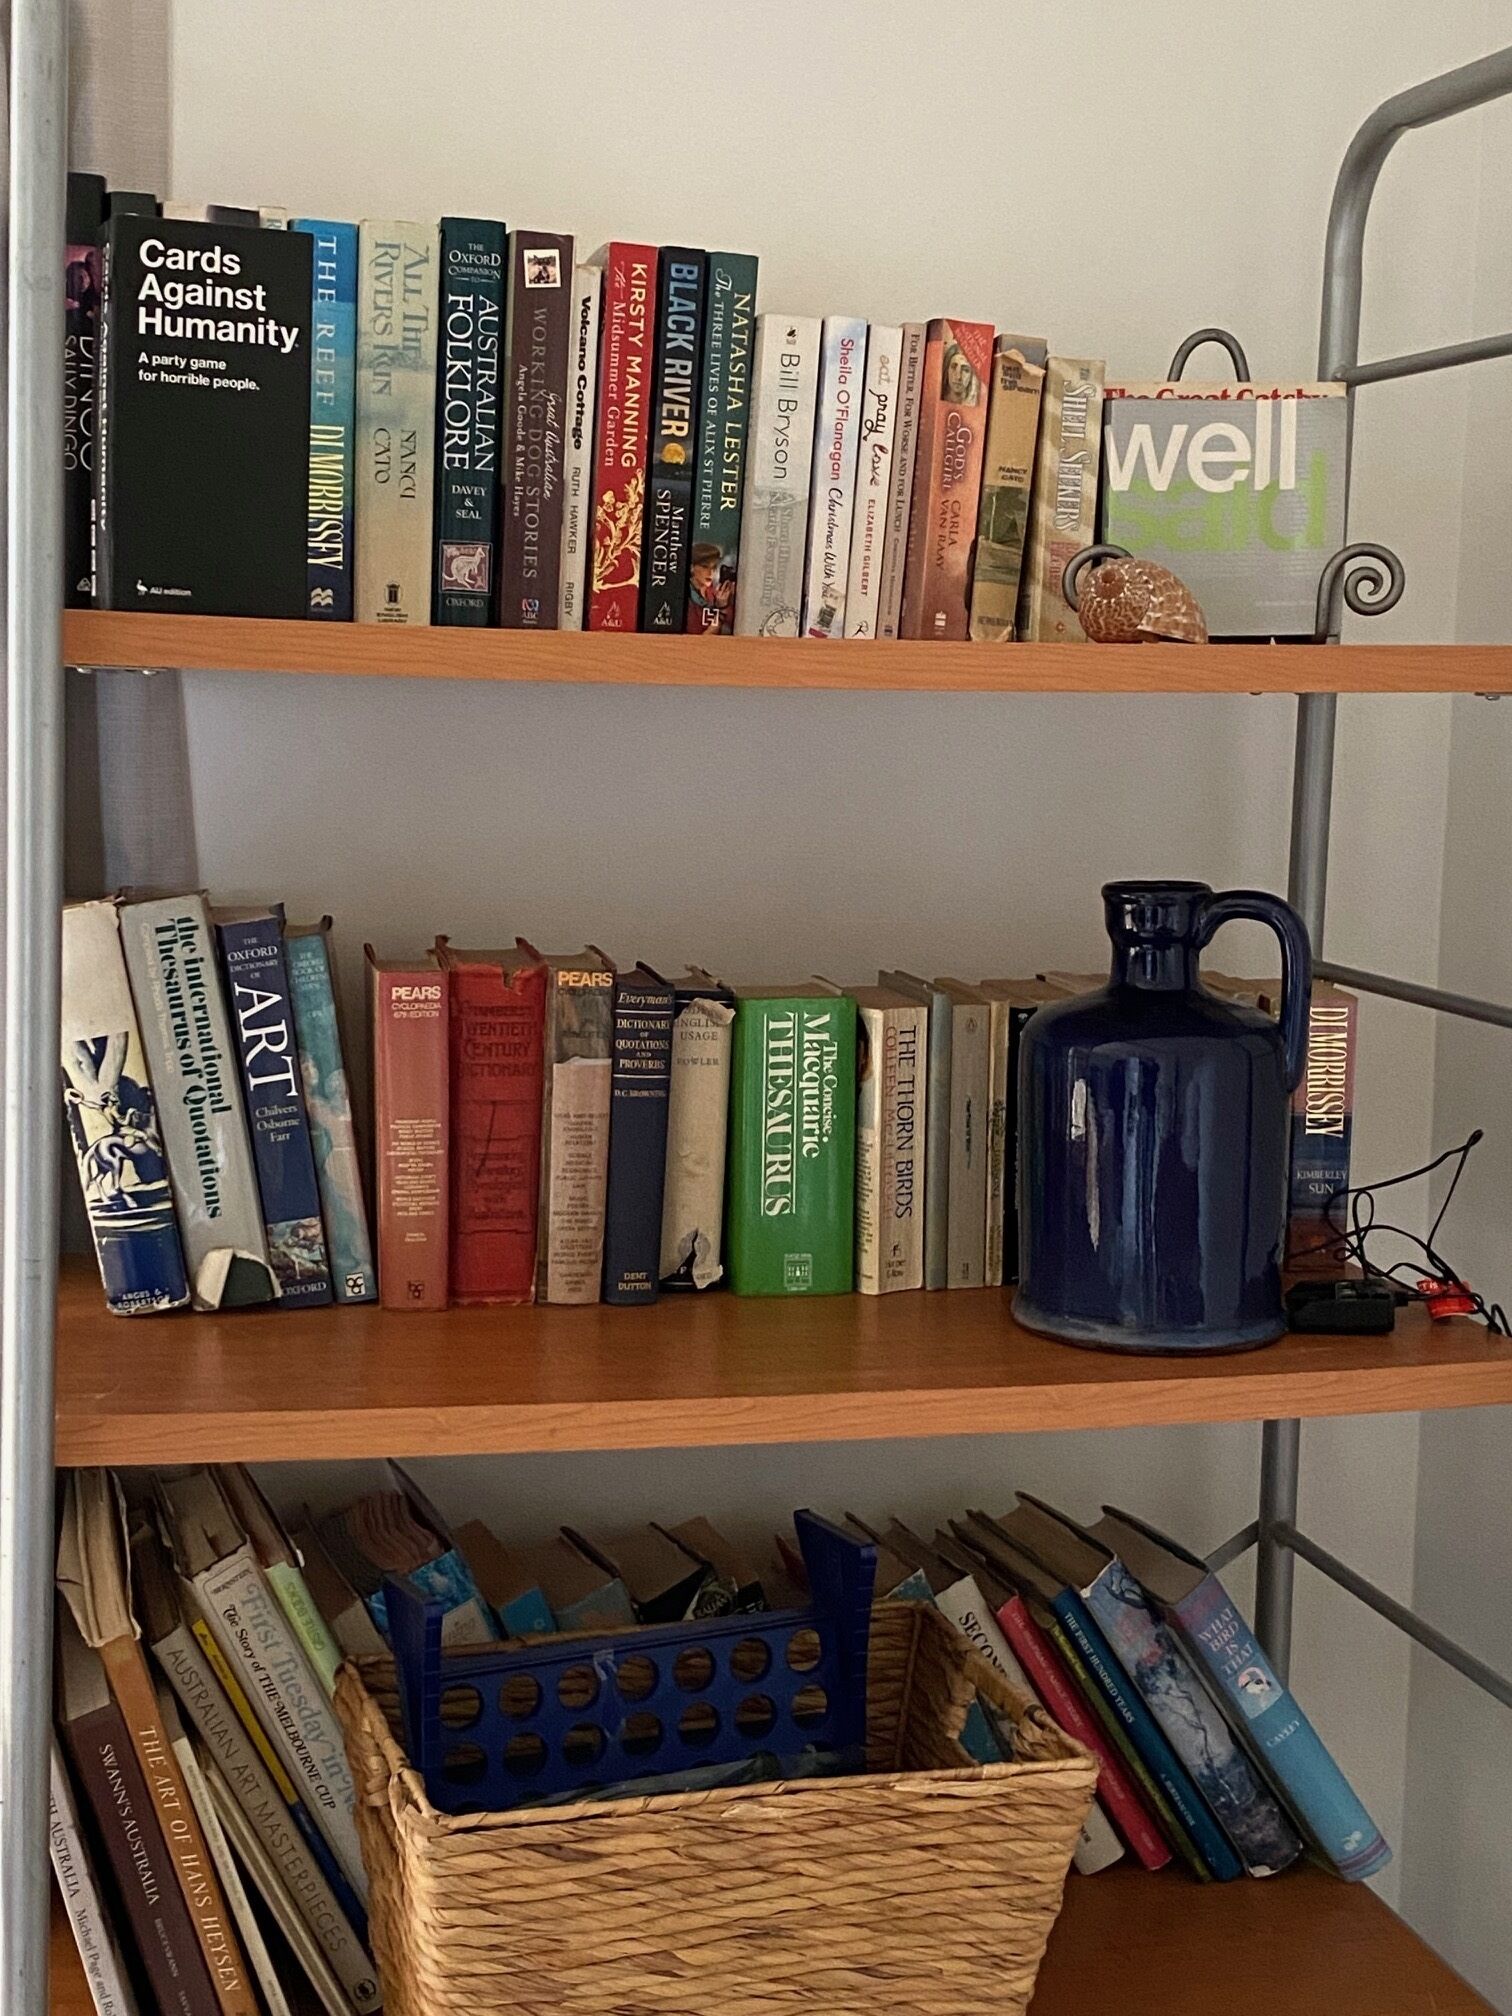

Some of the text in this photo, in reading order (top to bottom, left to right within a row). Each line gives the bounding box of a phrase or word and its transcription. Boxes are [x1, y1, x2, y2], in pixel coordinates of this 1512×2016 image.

[139, 239, 241, 276] Cards
[448, 265, 501, 279] COMPANION
[449, 249, 501, 267] OXFORD
[468, 243, 484, 251] THE
[138, 273, 267, 311] Against
[316, 235, 337, 405] THE REEF
[371, 241, 400, 397] RIVERS RUN
[402, 242, 430, 369] ALL THE
[138, 306, 300, 353] Humanity
[608, 301, 625, 399] Midsummer
[660, 262, 699, 437] BLACK RIVER
[138, 352, 227, 371] A party game
[138, 369, 260, 391] for horrible people.
[444, 293, 473, 471] FOLKLORE
[473, 294, 499, 472] AUSTRALIAN
[621, 263, 648, 468] KIRSTY MANNING
[838, 338, 855, 385] Sheila
[699, 267, 732, 530] The THREE LIVES OF ALIX ST PIERRE
[720, 291, 751, 512] NATASHA LESTER
[773, 353, 801, 479] Bill Bryson
[1060, 381, 1097, 443] SHELL
[373, 427, 391, 485] CATO
[523, 307, 547, 579] WORKING DOG STORIES
[542, 389, 562, 500] Great Australian
[563, 296, 592, 617] Volcano Cottage RUTH HAWKER RIGBY
[604, 405, 620, 468] Garden
[828, 389, 851, 481] O'Flanagan
[894, 333, 921, 534] FOR FOR WORSE AND FOR LUNCH
[943, 411, 961, 489] CALLGIRL
[953, 427, 973, 480] GOD'S
[1104, 399, 1297, 493] well
[398, 427, 417, 499] NANCY
[452, 484, 487, 497] DAVEY
[859, 353, 892, 597] eat pray love ELIZABETH GILBERT
[999, 466, 1028, 475] NANCY
[1054, 447, 1090, 532] SEEKERS
[307, 424, 345, 570] DI MORRISSEY
[455, 508, 482, 520] SEAL
[464, 497, 475, 507] &
[826, 487, 844, 550] Christmas
[939, 500, 950, 529] VAN
[948, 500, 961, 546] CARLA
[651, 488, 672, 588] SPENCER
[669, 506, 685, 574] Matthew
[823, 551, 836, 579] With
[227, 945, 278, 961] OXFORD
[558, 971, 613, 987] PEARS
[176, 915, 233, 1114] the international
[391, 985, 441, 1000] PEARS
[617, 992, 672, 1008] Everyman's
[234, 981, 299, 1097] ART
[615, 1039, 669, 1049] QUOTATIONS
[619, 1059, 666, 1070] PROVERBS
[680, 1031, 718, 1041] USAGE
[884, 1025, 898, 1098] COLLEEN
[155, 918, 223, 1219] Thesaurus of Quotations
[799, 1011, 831, 1159] Macquarie
[821, 1041, 838, 1135] The Concise
[1304, 1006, 1349, 1138] DI MORRISSEY
[254, 1103, 299, 1120] Chilvers
[270, 1131, 291, 1144] Farr
[764, 1011, 795, 1216] THESAURUS
[894, 1025, 917, 1219] THE THORN BIRDS
[1297, 1169, 1348, 1181] KIMBERLEY
[1308, 1183, 1334, 1194] SUN
[618, 1281, 652, 1290] DUTTON
[623, 1272, 648, 1280] DENT
[222, 1603, 239, 1627] The
[1198, 1608, 1233, 1641] WHAT
[1210, 1620, 1240, 1653] BIRD
[235, 1628, 256, 1665] Story
[240, 1584, 330, 1743] First Tuesday
[251, 1660, 266, 1677] of
[1064, 1611, 1077, 1631] THE
[1074, 1630, 1093, 1659] FIRST
[1091, 1657, 1118, 1698] HUNDRED
[1113, 1696, 1135, 1724] YEARS
[1223, 1642, 1255, 1675] THAT
[1225, 1641, 1238, 1655] IS
[258, 1675, 282, 1702] THE
[139, 1725, 167, 1769] THE
[273, 1701, 321, 1784] MELBOURNE
[154, 1774, 182, 1811] ART
[166, 1648, 240, 1760] AUSTRALIAN
[231, 1763, 261, 1795] ART
[254, 1801, 347, 1953] MASTERPIECES
[314, 1783, 337, 1810] CUP
[100, 1743, 160, 1906] SWANN'S AUSTRALIA
[169, 1819, 193, 1844] OF
[51, 1818, 80, 1898] AUSTRALIA
[74, 1908, 97, 1952] Michael
[88, 1952, 102, 1979] Page
[96, 1979, 111, 2000] and
[180, 1854, 213, 1909] HANS
[200, 1916, 241, 1993] HEYSEN
